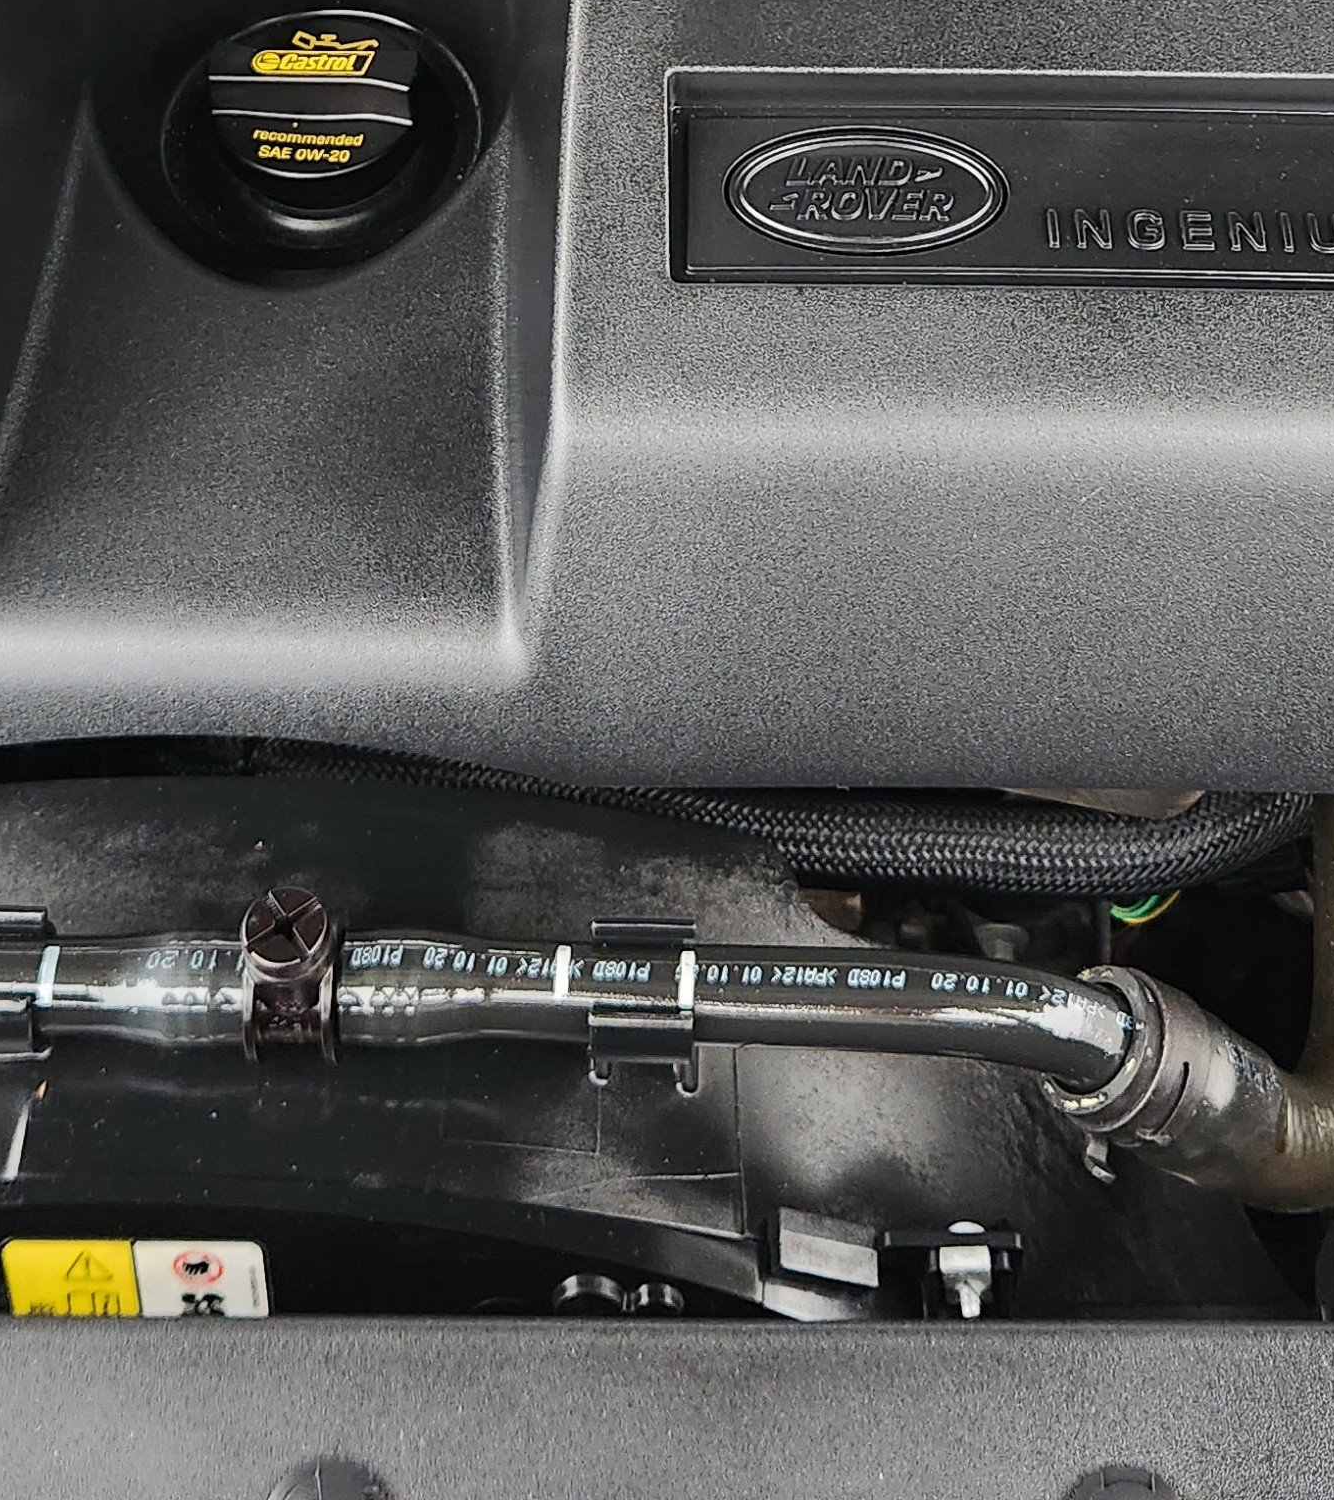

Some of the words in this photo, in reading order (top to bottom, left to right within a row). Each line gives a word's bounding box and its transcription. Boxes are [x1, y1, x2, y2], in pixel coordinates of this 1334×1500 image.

[278, 53, 357, 71] Castrol
[252, 128, 365, 147] recommended
[257, 144, 293, 160] SAE
[294, 148, 351, 163] 0W-20
[784, 156, 914, 187] LAND
[795, 187, 955, 222] ROVER
[349, 944, 404, 970] P108D
[422, 946, 509, 977] 01.10.20
[591, 959, 652, 983] P108D
[930, 971, 1030, 1000] 01.10.20
